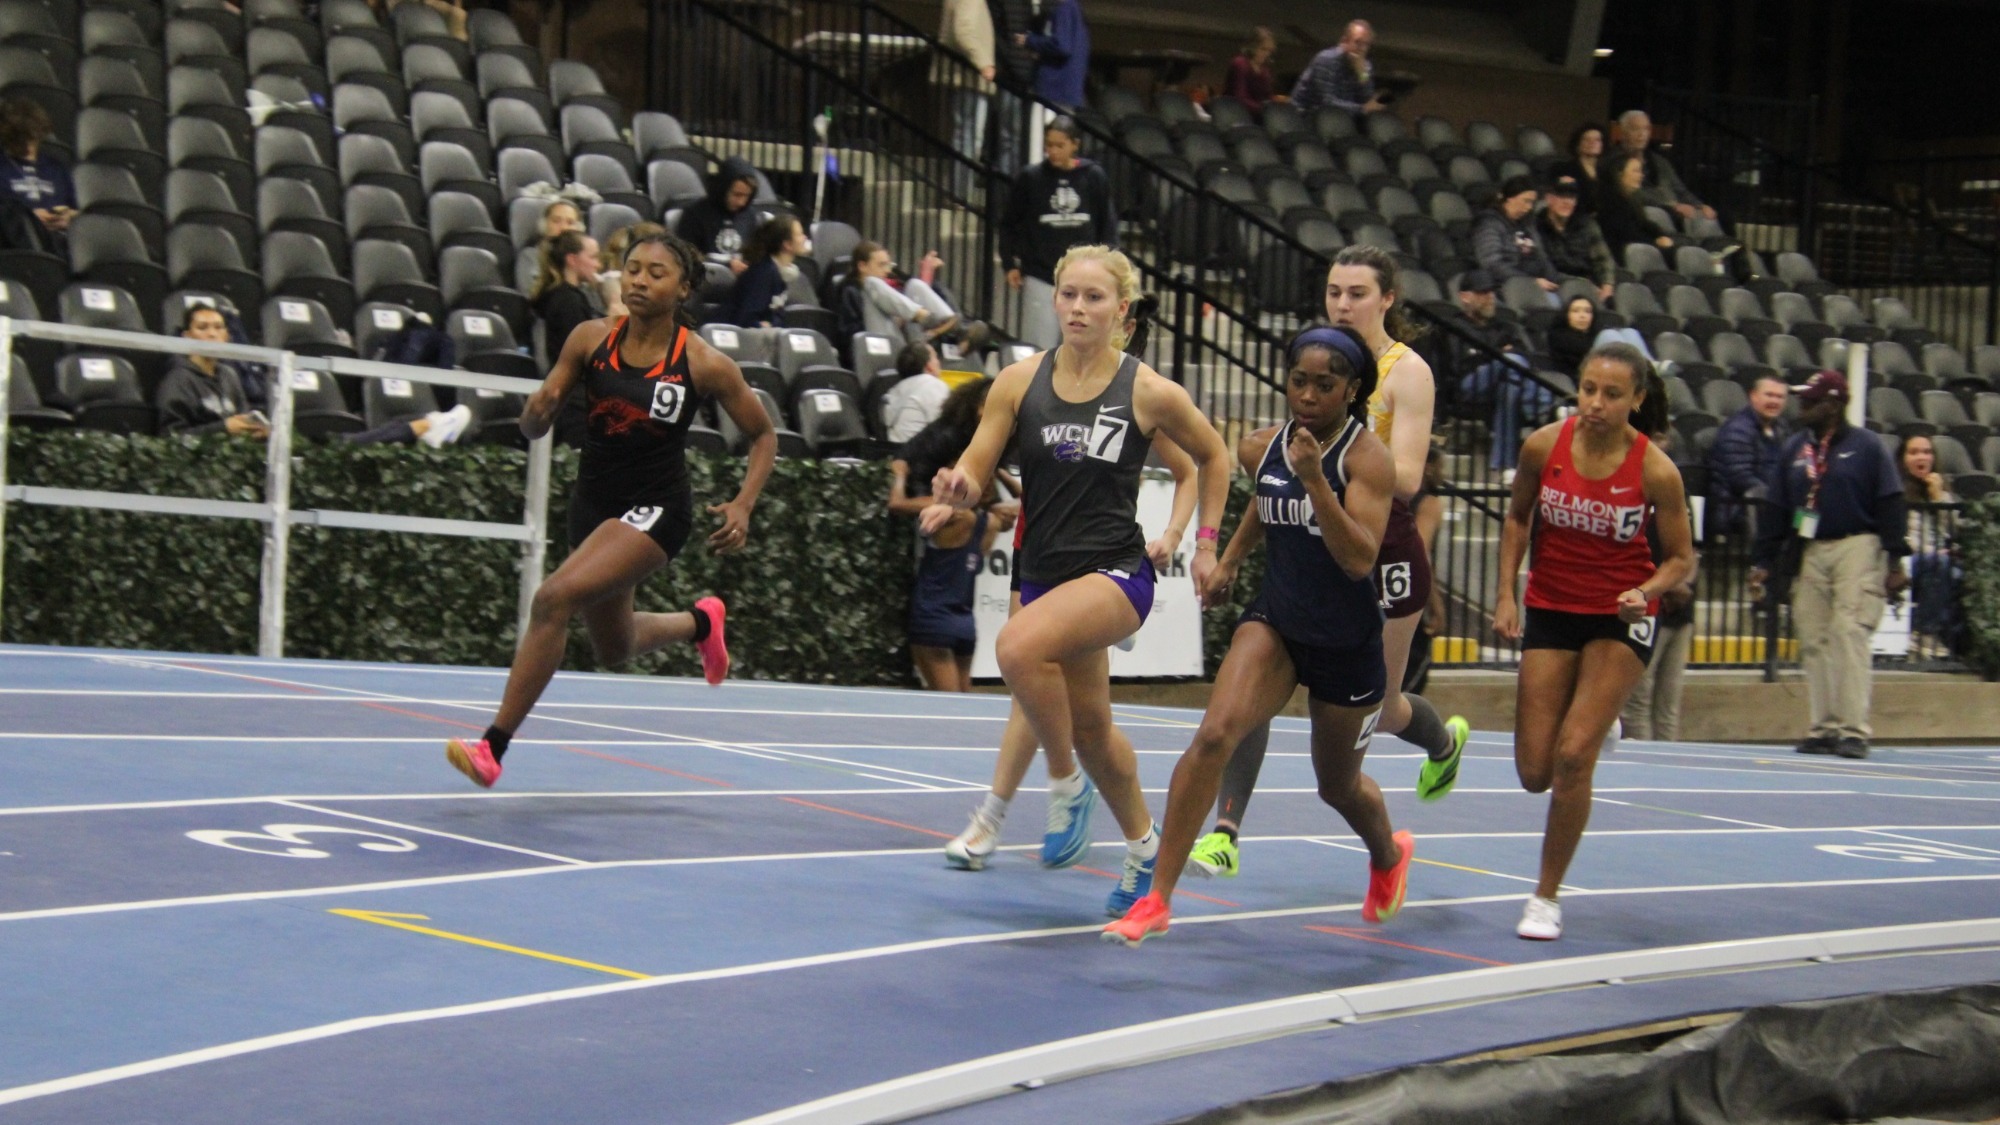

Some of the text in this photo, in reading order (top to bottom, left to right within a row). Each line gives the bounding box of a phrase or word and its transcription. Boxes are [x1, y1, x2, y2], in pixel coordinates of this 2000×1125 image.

[653, 385, 679, 418] 9
[1095, 418, 1124, 457] 7
[628, 505, 655, 525] 9
[1257, 495, 1309, 527] ULLDO
[1541, 485, 1618, 521] BELMON
[1618, 508, 1643, 540] 5
[1385, 564, 1407, 598] 6
